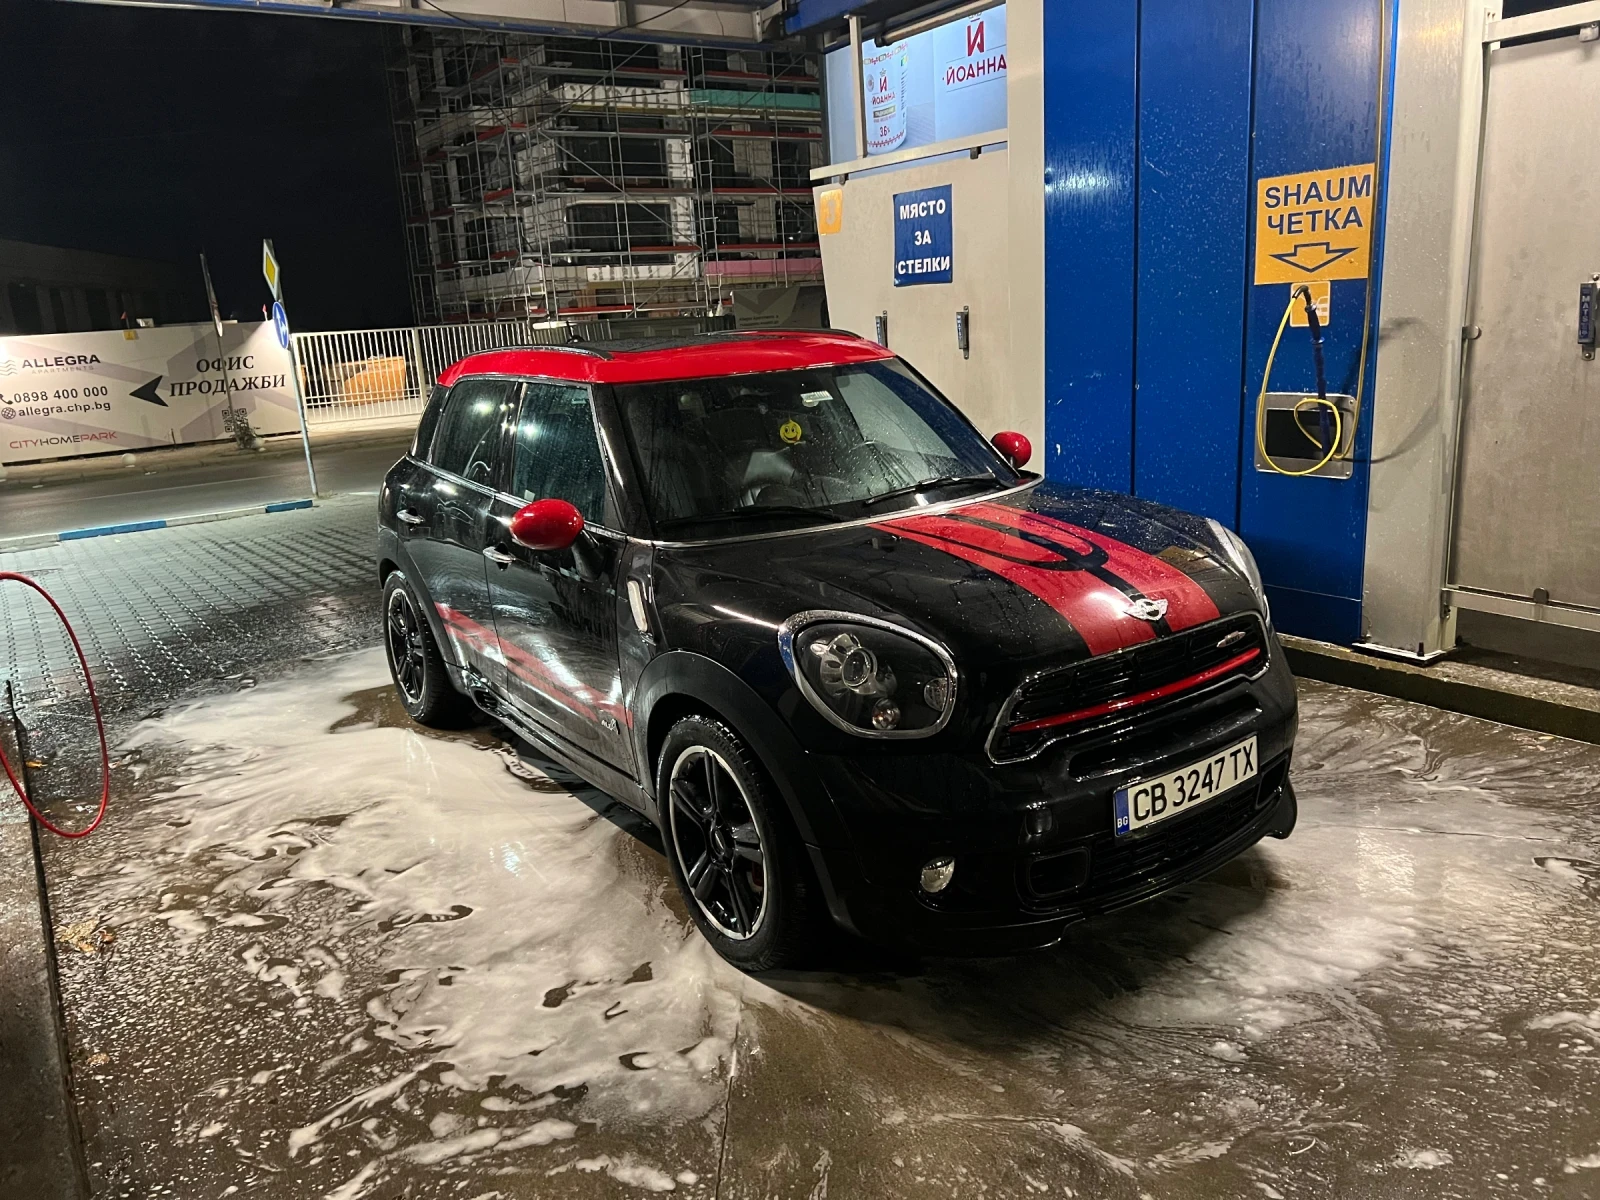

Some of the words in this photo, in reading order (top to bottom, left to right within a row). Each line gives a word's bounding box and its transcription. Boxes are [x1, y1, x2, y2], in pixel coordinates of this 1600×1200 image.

[945, 53, 1007, 86] ЙОАННА
[1264, 174, 1371, 209] SHAUM
[900, 199, 946, 220] МЯСТО
[1267, 206, 1363, 235] ЧЕТКА
[914, 230, 932, 246] ЗА
[897, 256, 950, 275] СТЕЛКИ
[22, 354, 101, 369] ALLEGRA
[31, 365, 94, 375] APARTMENTS
[196, 356, 254, 373] ОФИС
[13, 390, 48, 403] 0898
[53, 388, 78, 400] 400
[83, 386, 108, 398] 000
[169, 374, 286, 397] ПРОДАЖБИ
[18, 401, 111, 417] allegra.chp.bg
[9, 431, 118, 449] CITYHOMEPARK
[1133, 782, 1167, 822] CB
[1172, 756, 1226, 807] 3247
[1229, 742, 1254, 781] TX
[1117, 816, 1128, 828] BG
